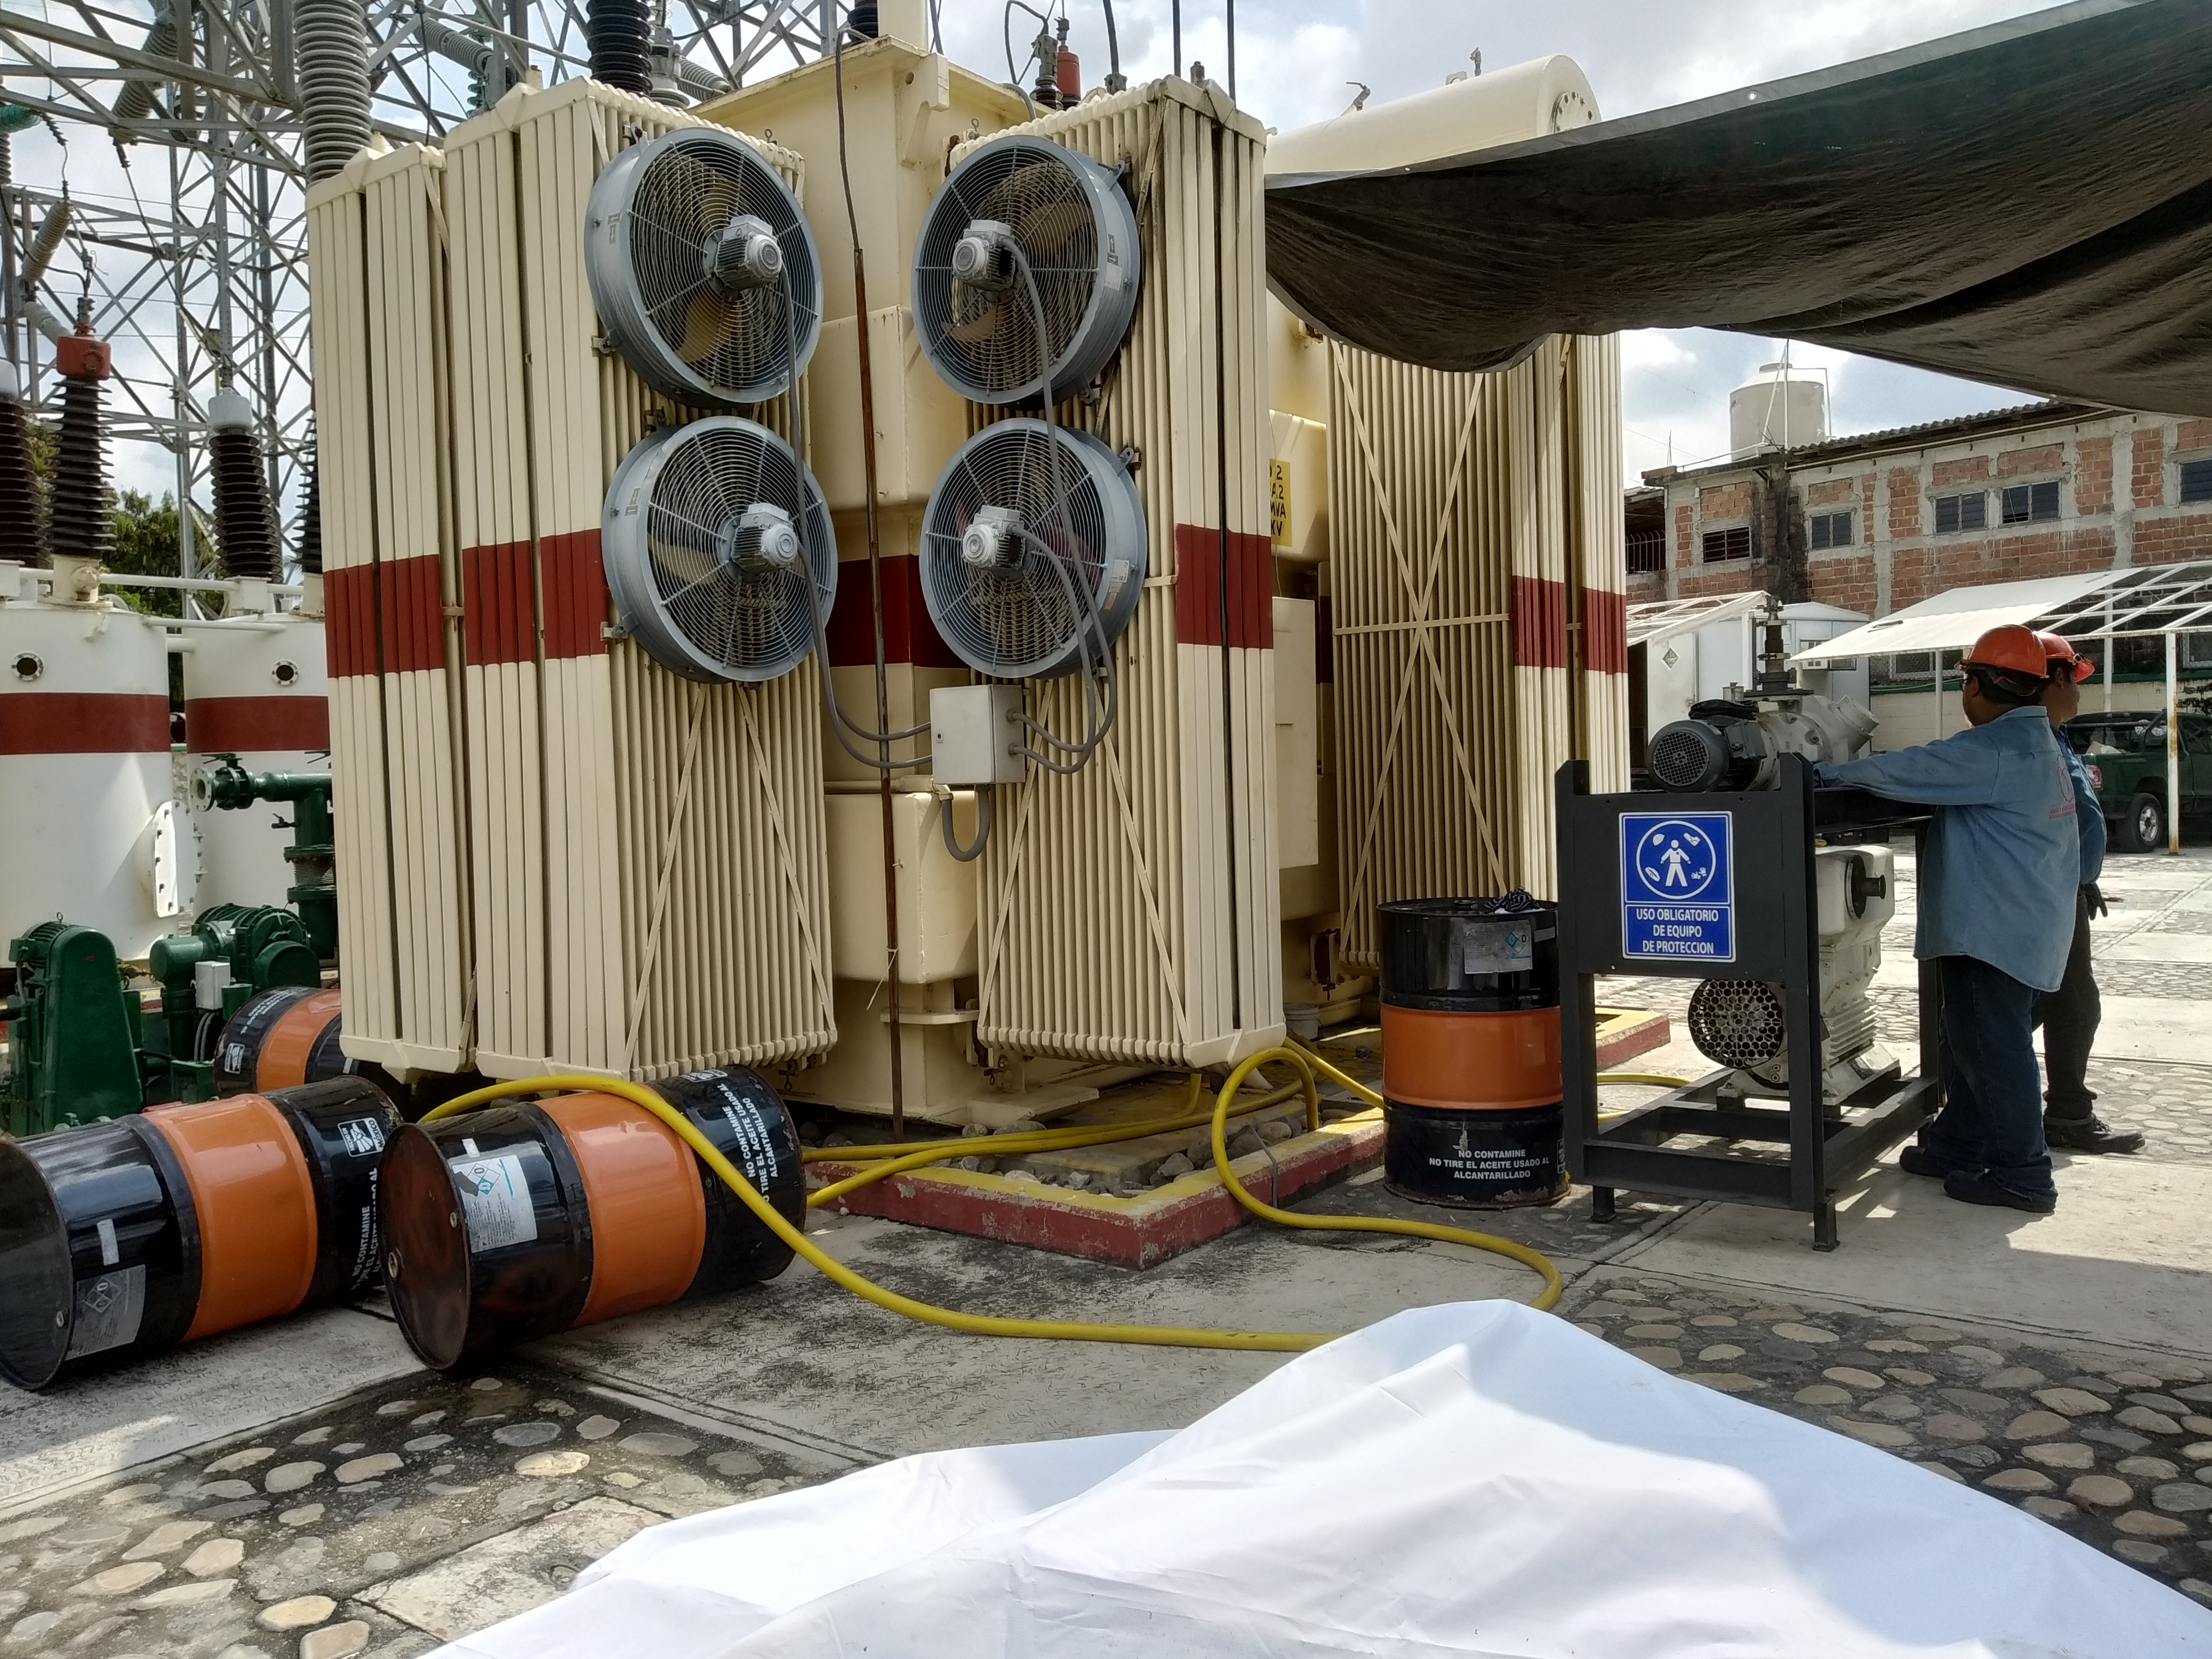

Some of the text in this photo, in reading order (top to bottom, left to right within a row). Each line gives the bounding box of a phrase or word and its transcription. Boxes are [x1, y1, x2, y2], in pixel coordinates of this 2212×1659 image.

[1276, 465, 1283, 481] 2
[1636, 908, 1719, 922] USO OBLIGATORIO
[1521, 934, 1526, 943] 0
[1653, 925, 1702, 938] DE EQUIPO
[1642, 940, 1714, 954] DE PROTECCION
[717, 1083, 729, 1091] AL
[724, 1091, 746, 1117] USADO
[742, 1117, 761, 1150] ACEITE
[742, 1097, 778, 1178] ALCANTARILLADO
[345, 1134, 356, 1151] HECHO
[722, 1105, 756, 1178] NO CONTAMINE
[755, 1152, 765, 1166] EL
[1458, 1149, 1526, 1159] NO CONTAMINE
[1429, 1157, 1550, 1170] NO TIRE EL ACEITE USADO AL
[369, 1167, 378, 1181] AL
[758, 1167, 769, 1193] TIRE
[1453, 1170, 1531, 1180] ALCANTARILLADO
[352, 1206, 370, 1276] NO CONTAMINE
[365, 1256, 375, 1267] EL
[97, 1282, 109, 1291] 0
